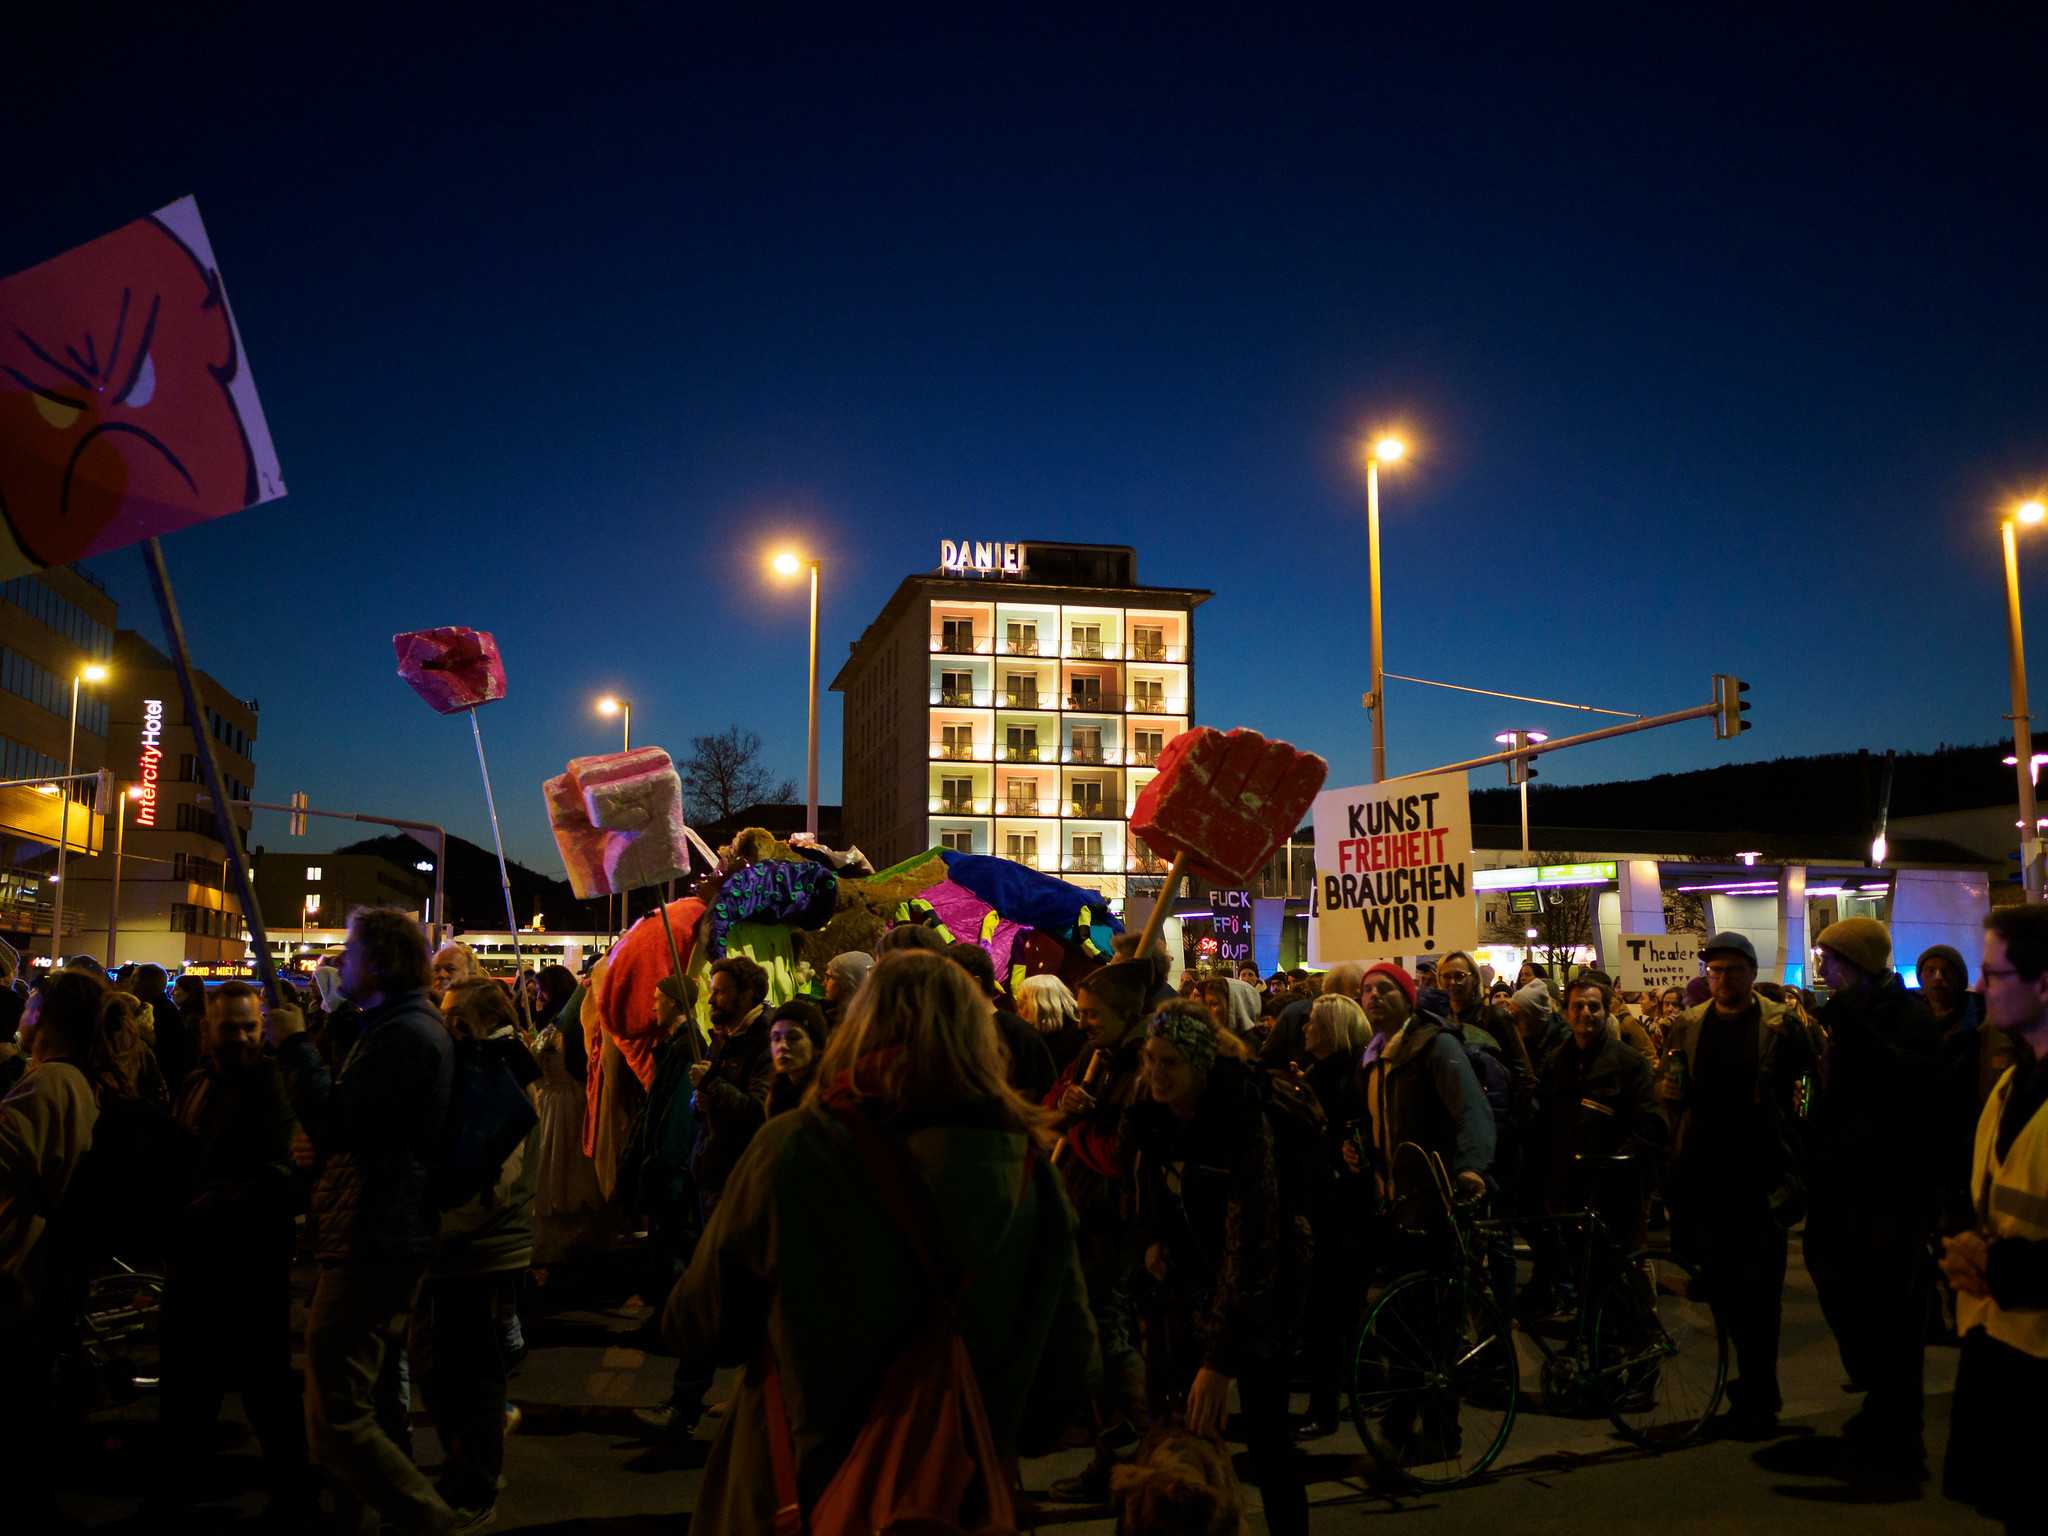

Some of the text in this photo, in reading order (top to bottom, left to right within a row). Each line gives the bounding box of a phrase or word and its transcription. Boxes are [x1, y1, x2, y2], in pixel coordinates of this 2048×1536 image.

[1348, 792, 1439, 838] KUNST
[1339, 827, 1449, 874] FREIHEIT
[1325, 862, 1465, 910] BRAUCHEN
[1209, 890, 1251, 908] FUCK
[1213, 915, 1251, 935] FPÖ +
[1221, 940, 1249, 960] ÖVP
[1626, 940, 1694, 962] Theater
